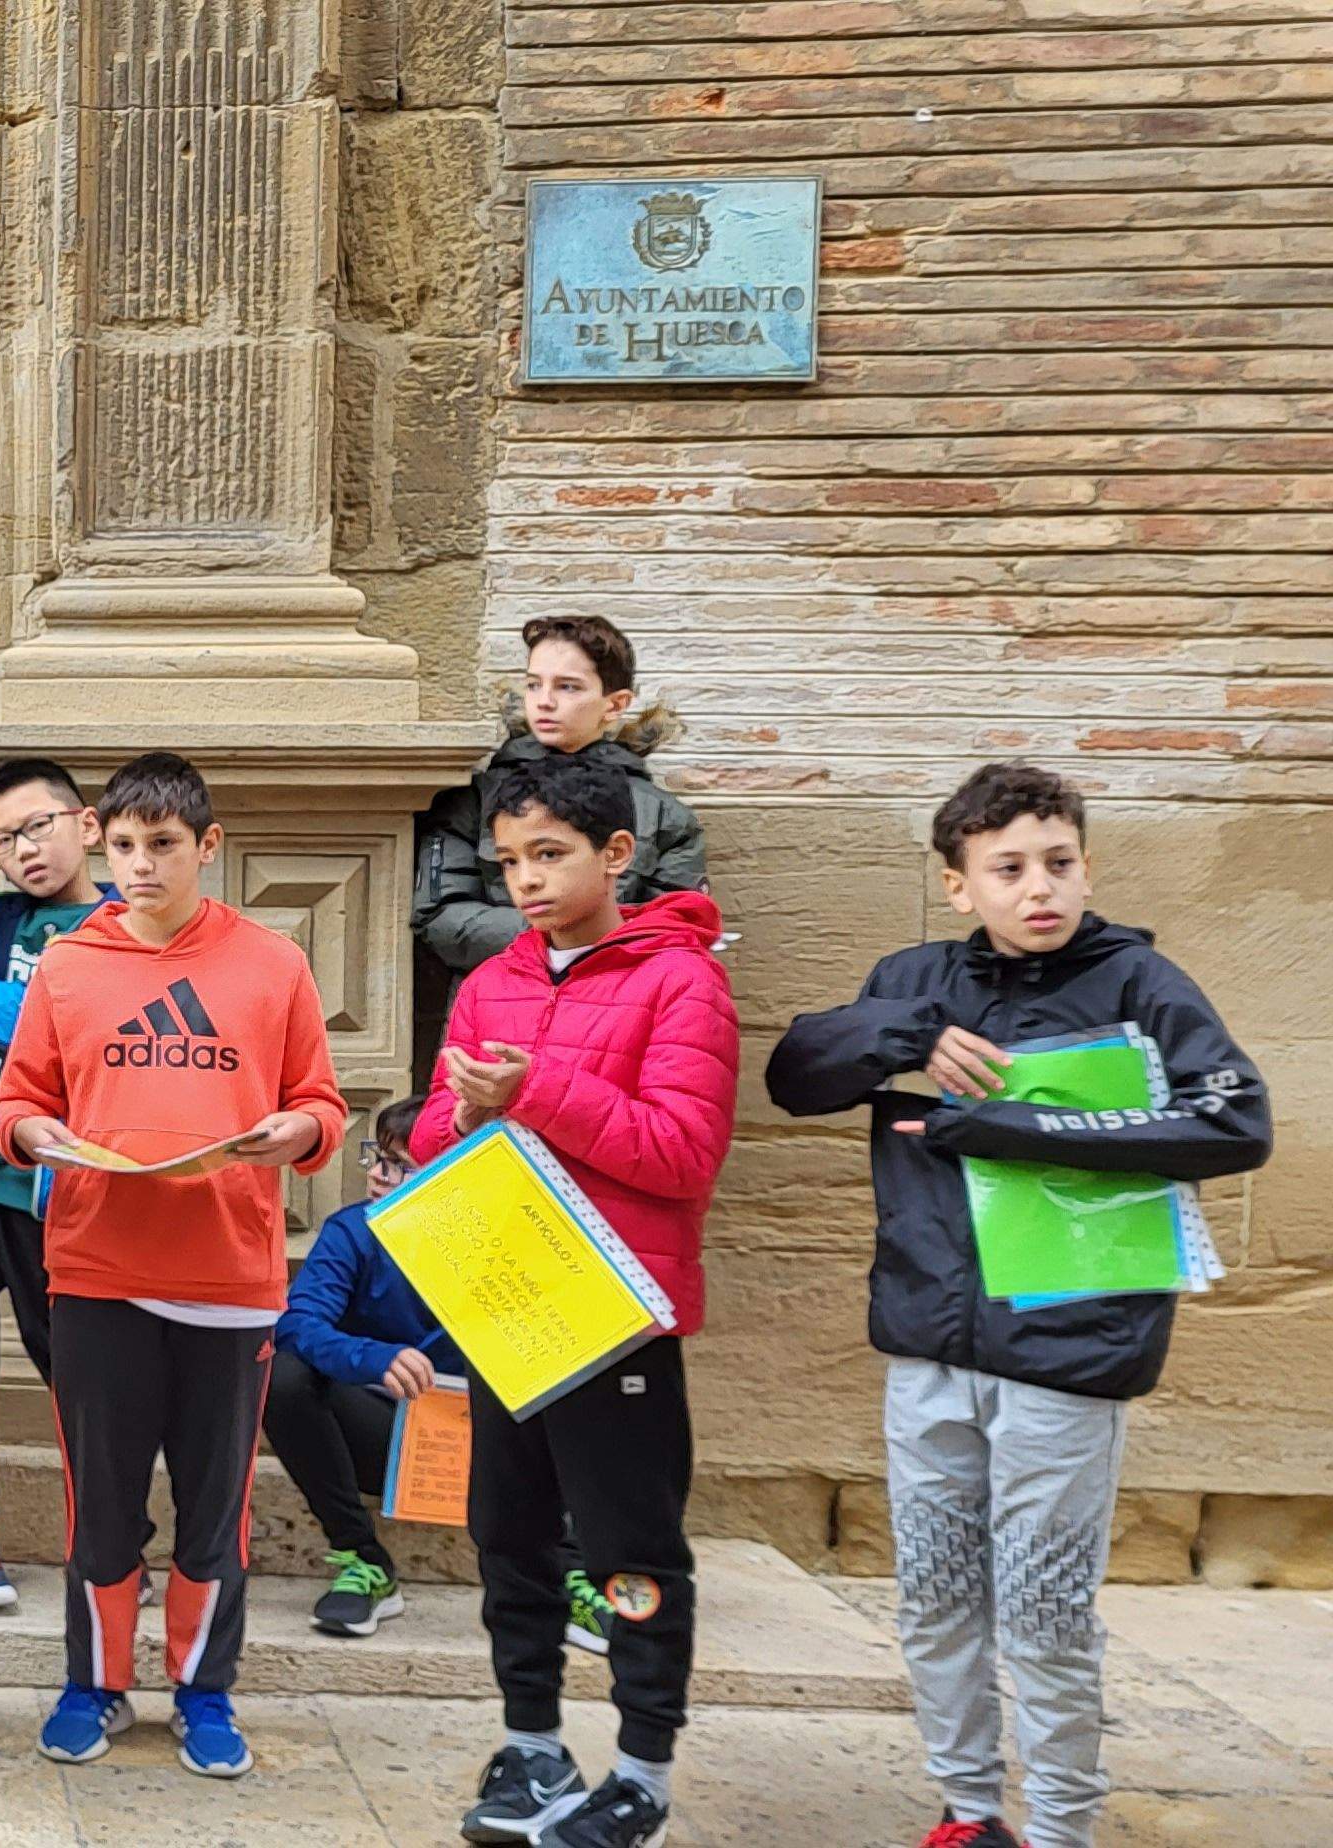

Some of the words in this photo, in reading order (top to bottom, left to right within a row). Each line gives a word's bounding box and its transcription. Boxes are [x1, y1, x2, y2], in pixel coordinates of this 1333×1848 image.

[540, 276, 805, 315] AYUNTAMIENTO
[575, 323, 610, 346] DE
[622, 320, 766, 363] HUESCA
[103, 1035, 241, 1072] adidas
